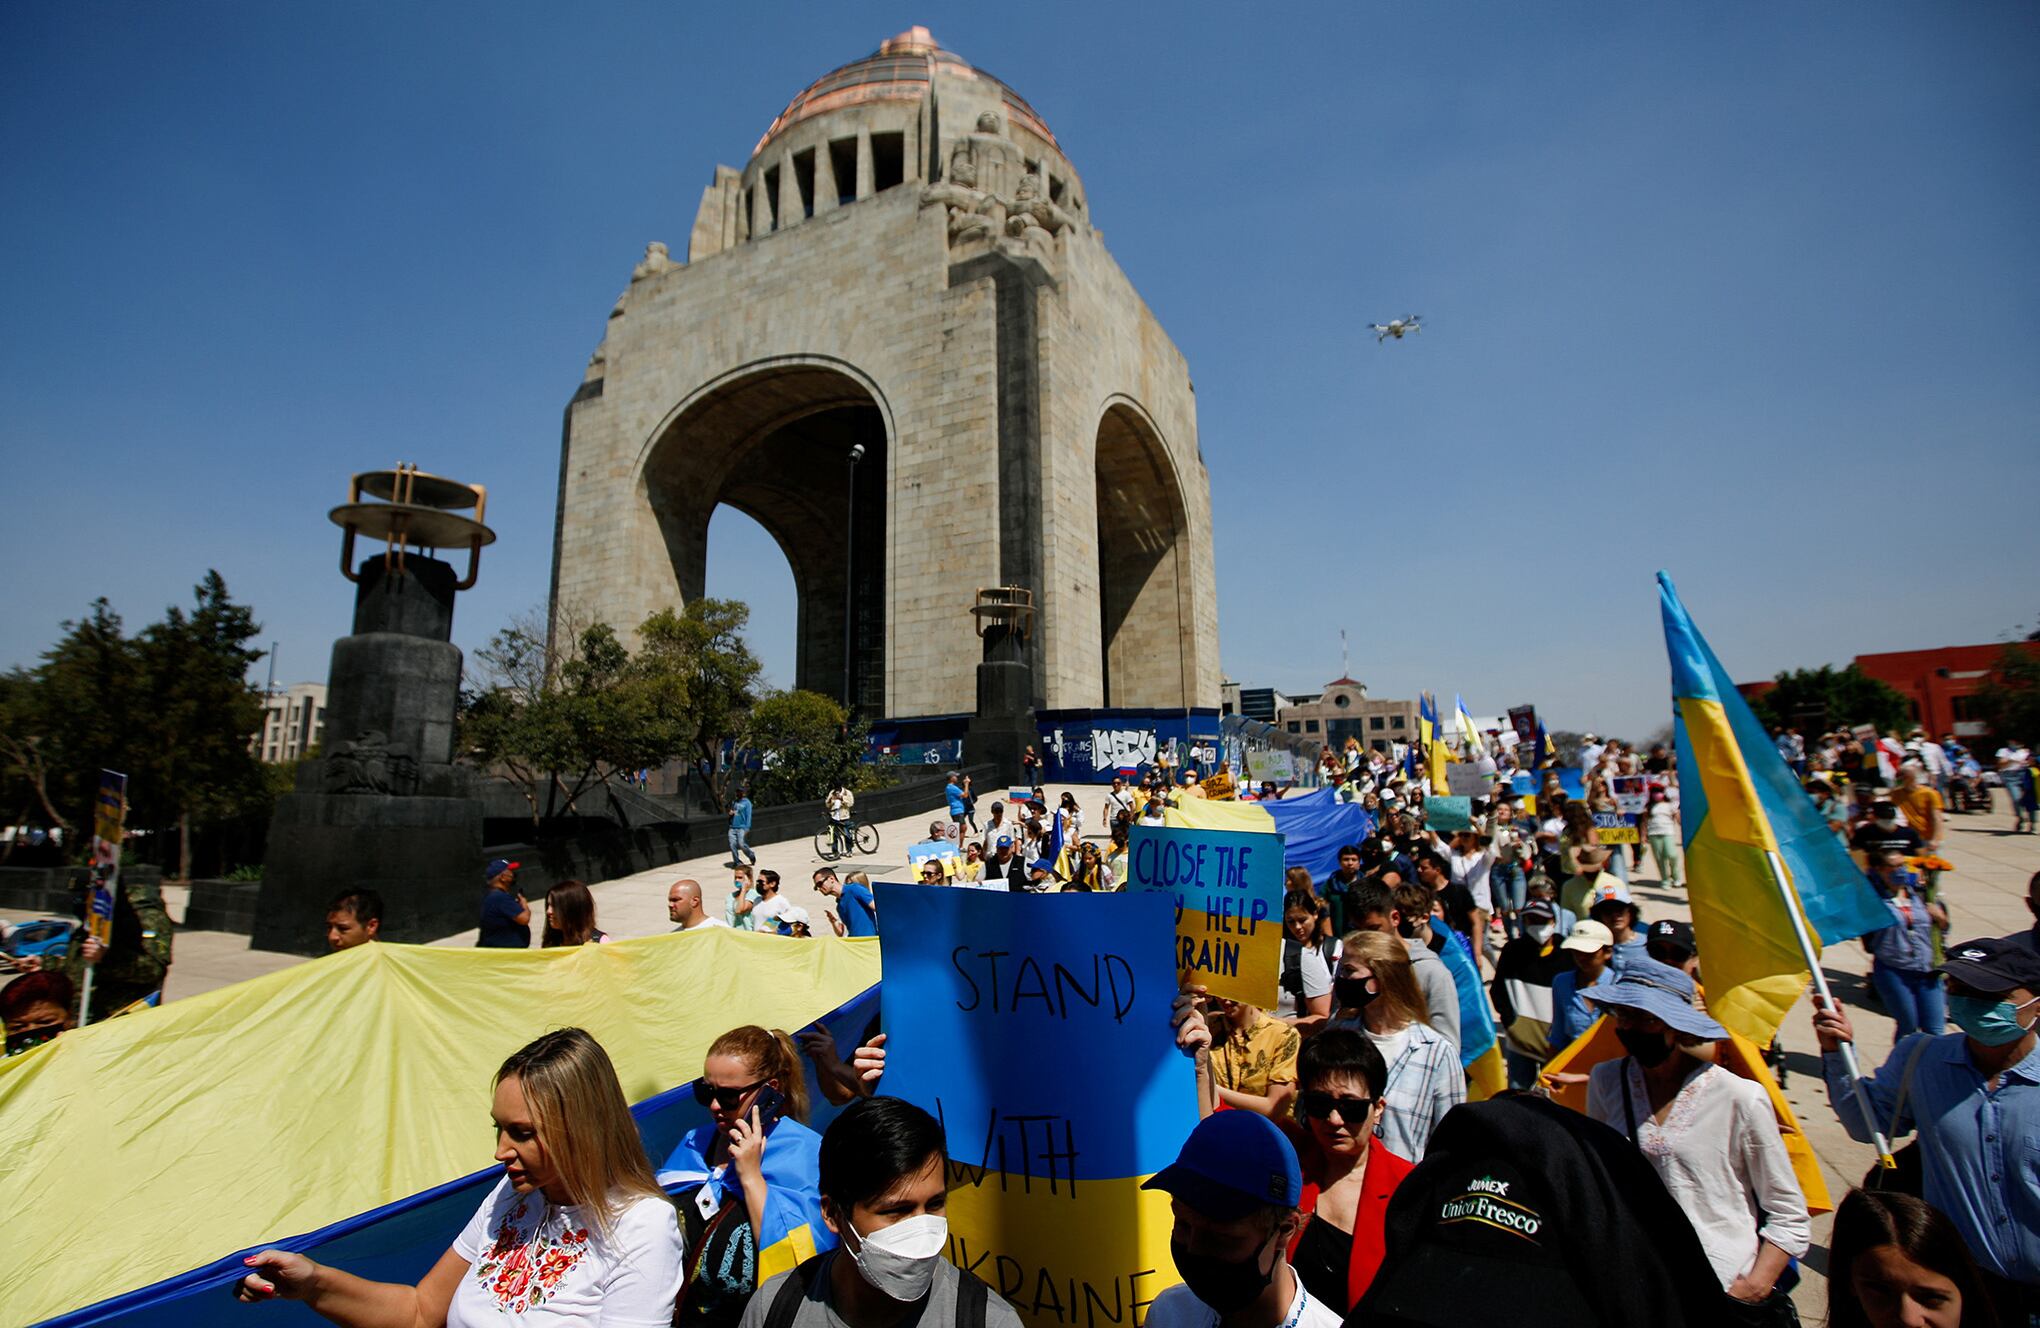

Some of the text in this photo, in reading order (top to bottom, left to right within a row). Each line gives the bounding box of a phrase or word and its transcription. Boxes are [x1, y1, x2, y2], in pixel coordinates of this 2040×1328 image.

[1136, 838, 1207, 888] CLOSE
[1206, 895, 1268, 936] HELP
[952, 946, 1135, 1024] STAND
[936, 1097, 1080, 1199] WITH
[1467, 1179, 1509, 1196] JUMEX
[1475, 1197, 1539, 1234] Fresco
